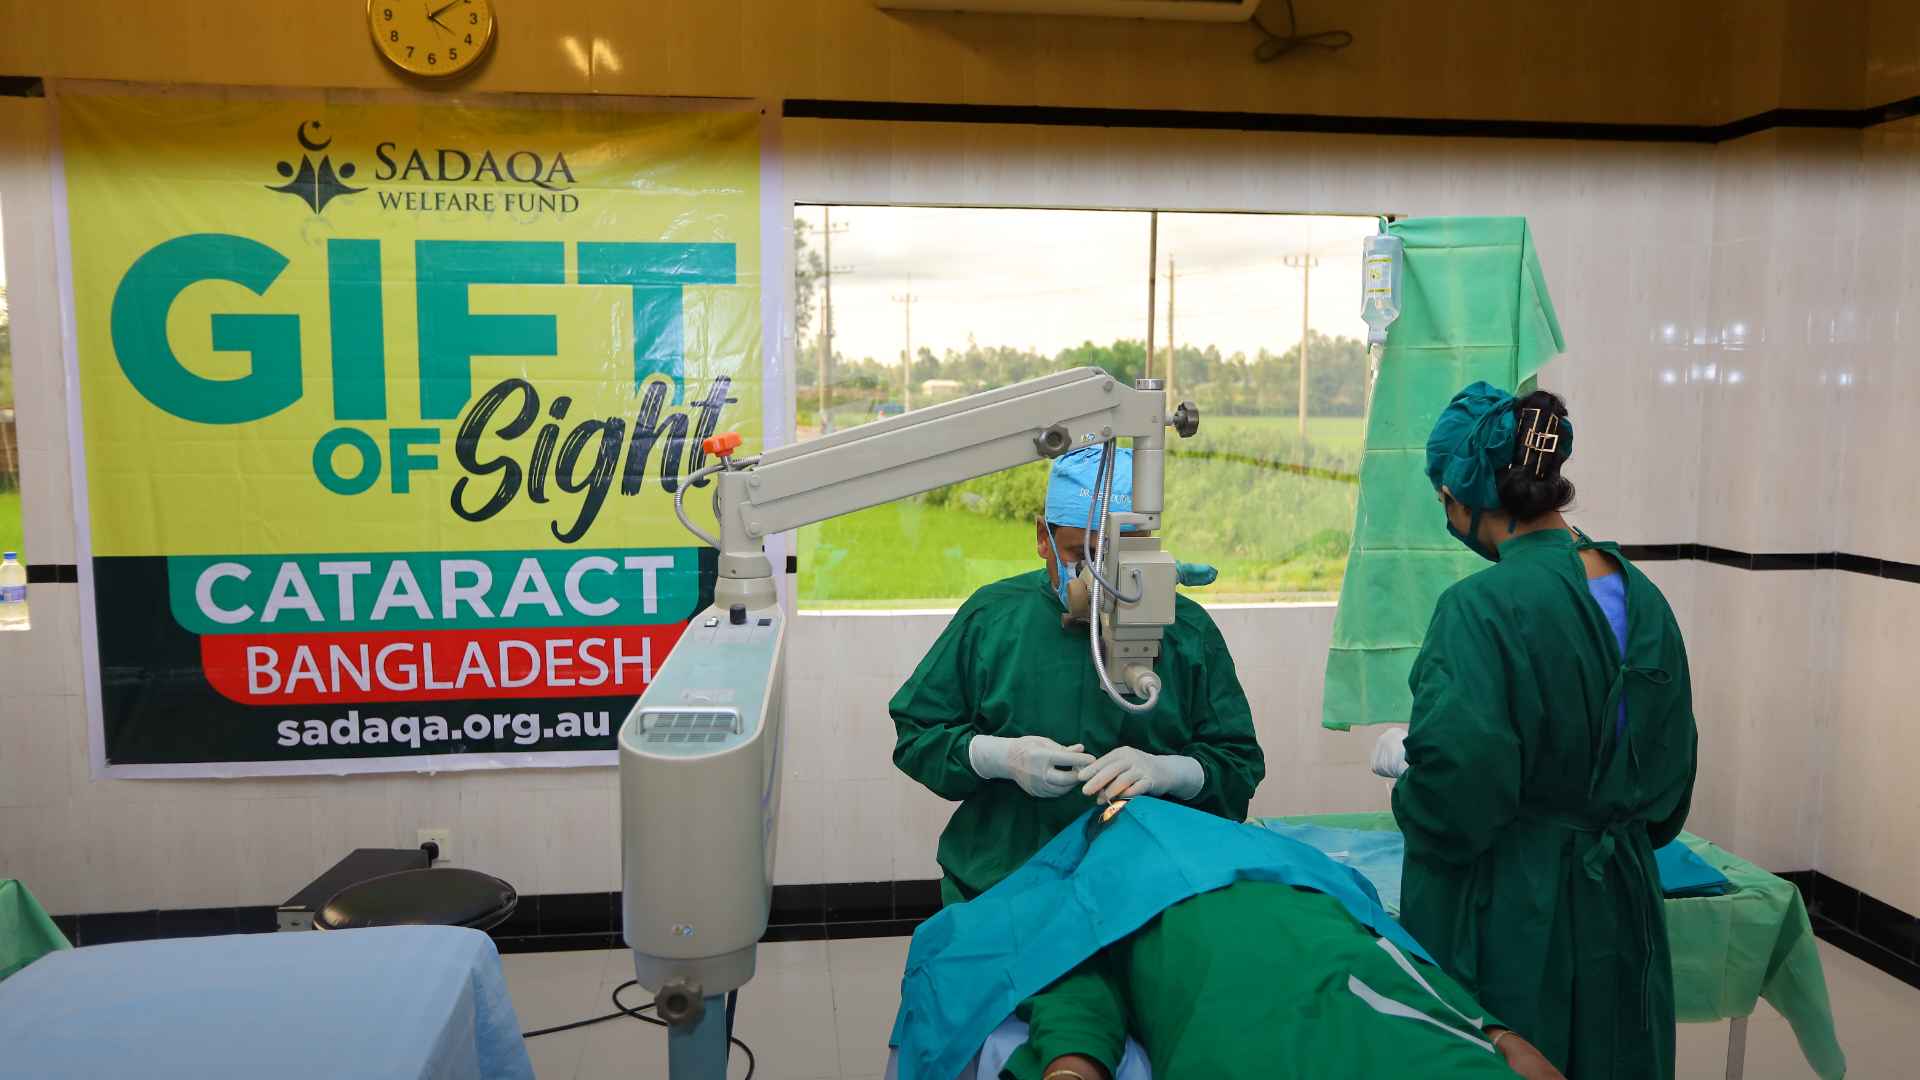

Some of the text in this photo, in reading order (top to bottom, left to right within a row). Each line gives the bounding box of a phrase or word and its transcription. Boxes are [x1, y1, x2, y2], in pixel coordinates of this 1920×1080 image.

[384, 9, 392, 21] 9
[470, 13, 478, 25] 3
[391, 31, 399, 42] 8
[464, 33, 472, 45] 4
[406, 46, 414, 58] 7
[428, 53, 436, 65] 6
[449, 48, 457, 60] 5
[375, 142, 578, 191] SADAQA
[378, 191, 579, 213] WELFARE FUND
[111, 233, 736, 425] GIFT
[312, 375, 738, 544] OF Sight
[195, 555, 674, 625] CATARACT
[246, 636, 652, 696] BANGLADESH
[277, 710, 610, 748] sadaqa.org.au
